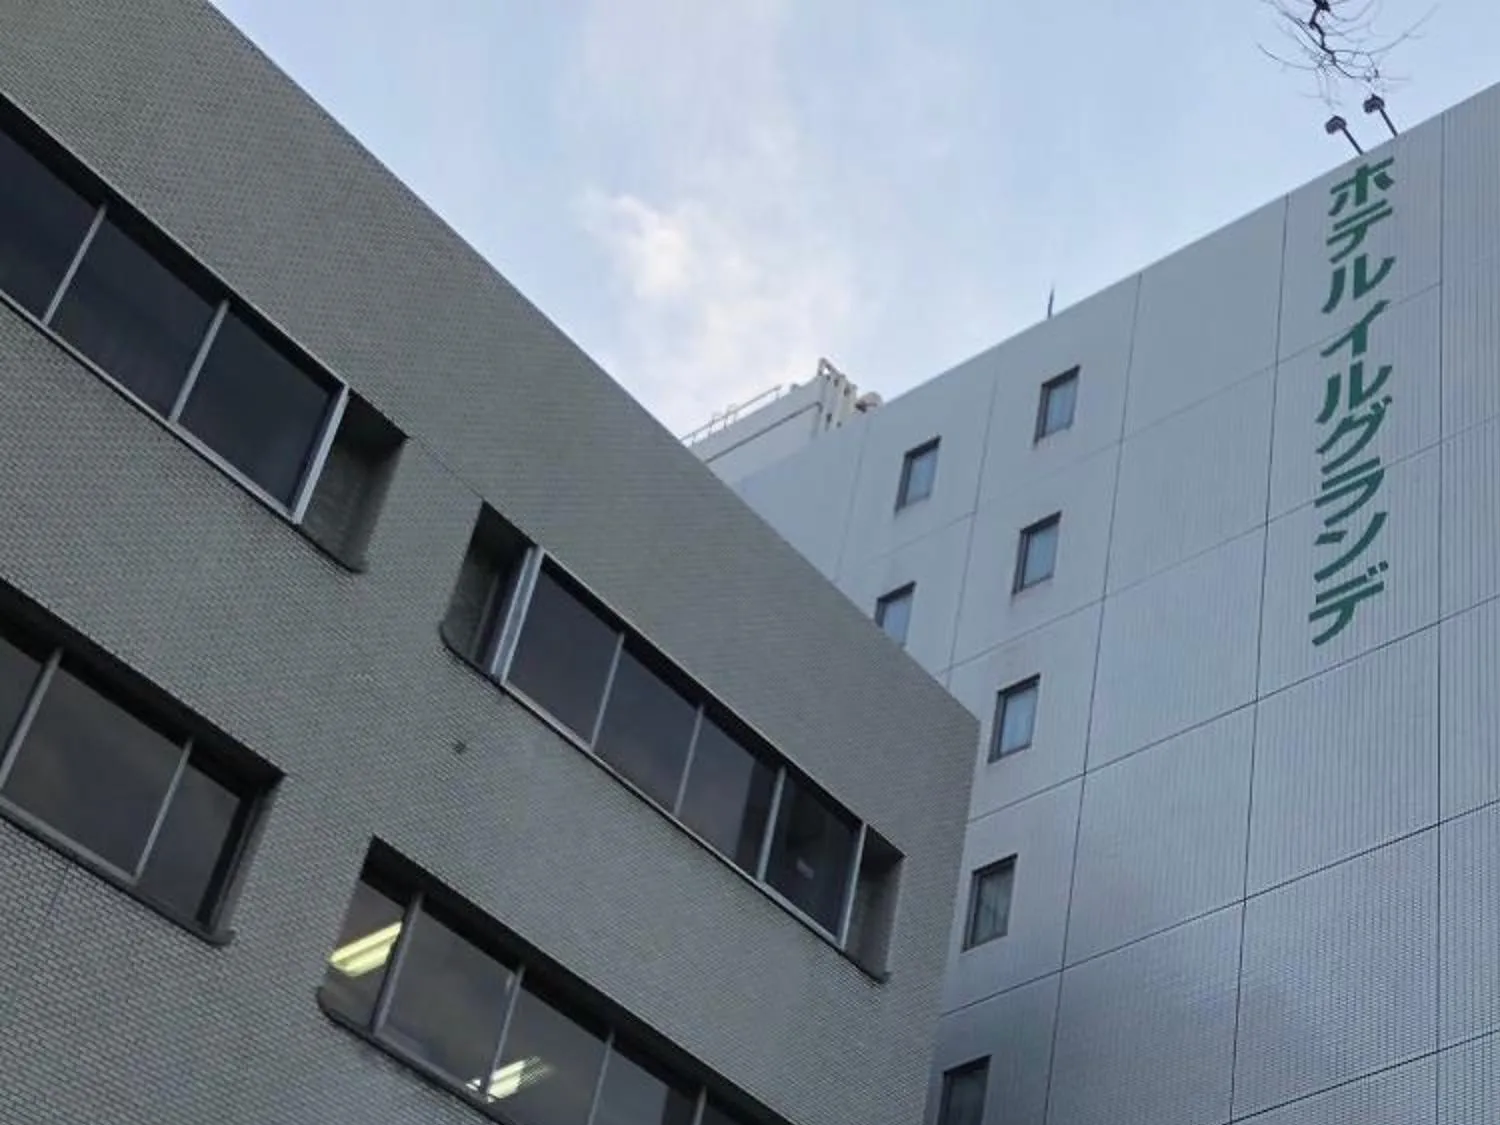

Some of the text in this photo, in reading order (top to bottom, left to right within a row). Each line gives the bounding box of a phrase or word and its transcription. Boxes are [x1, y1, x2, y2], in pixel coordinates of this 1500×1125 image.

[1309, 157, 1396, 647] ホテルイルグランデ
